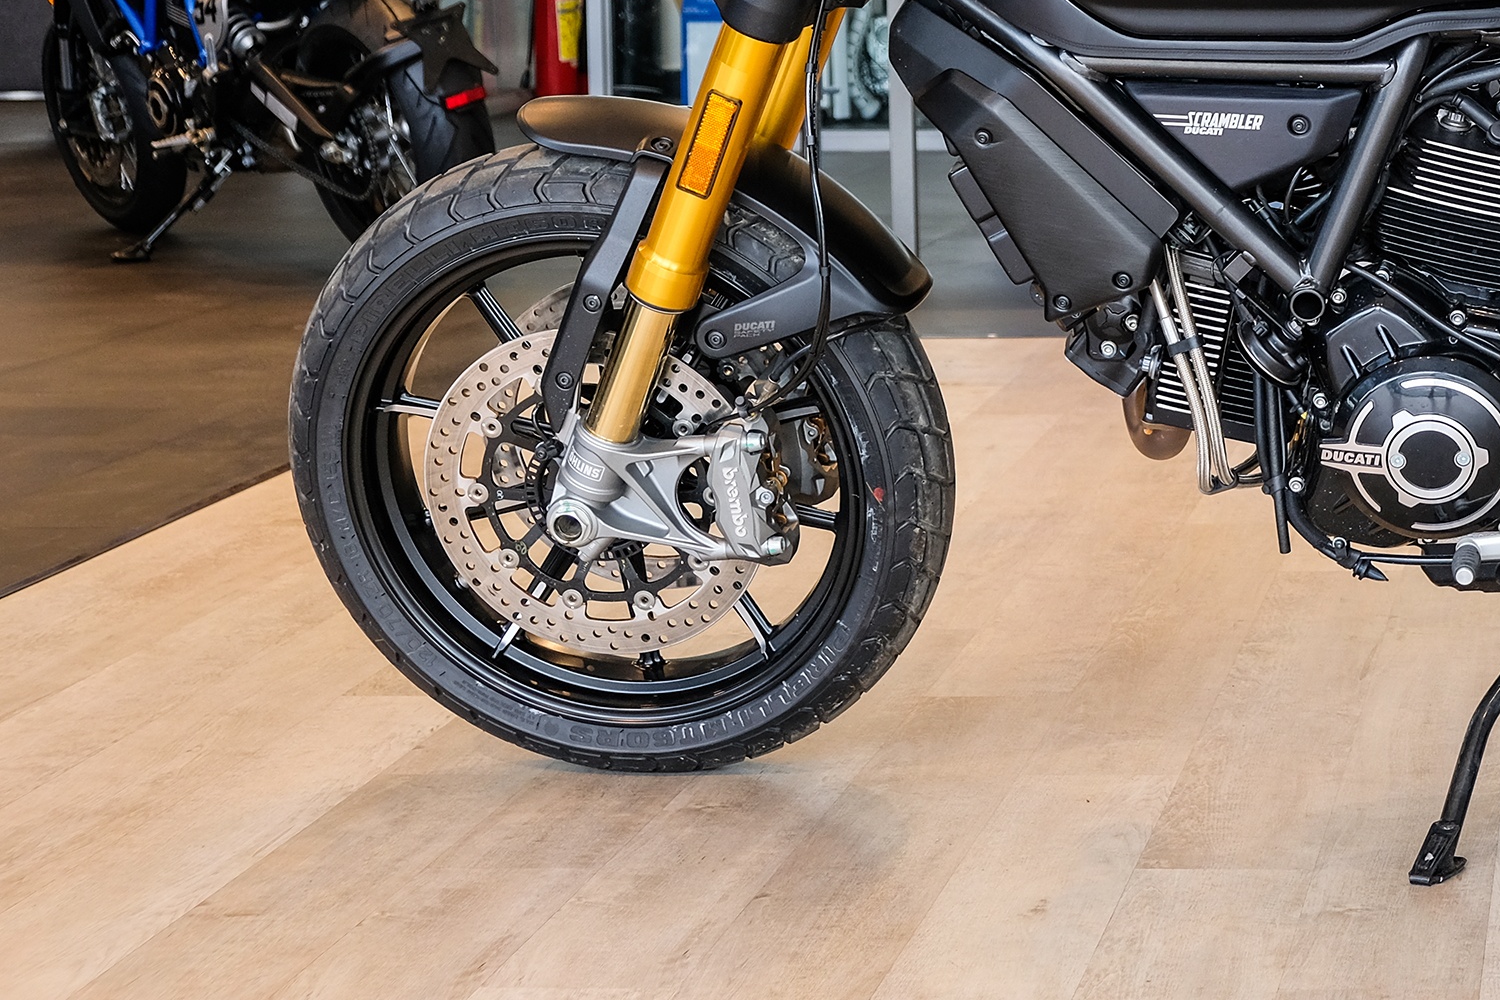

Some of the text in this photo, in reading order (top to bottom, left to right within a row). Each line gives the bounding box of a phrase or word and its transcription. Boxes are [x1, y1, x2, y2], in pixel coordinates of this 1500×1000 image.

[1187, 111, 1264, 131] SCRAMBLER
[1184, 126, 1224, 136] DUCATI
[734, 320, 776, 331] DUCATI
[1321, 449, 1381, 466] DUCATI
[721, 466, 749, 538] brembo
[568, 723, 622, 749] RS
